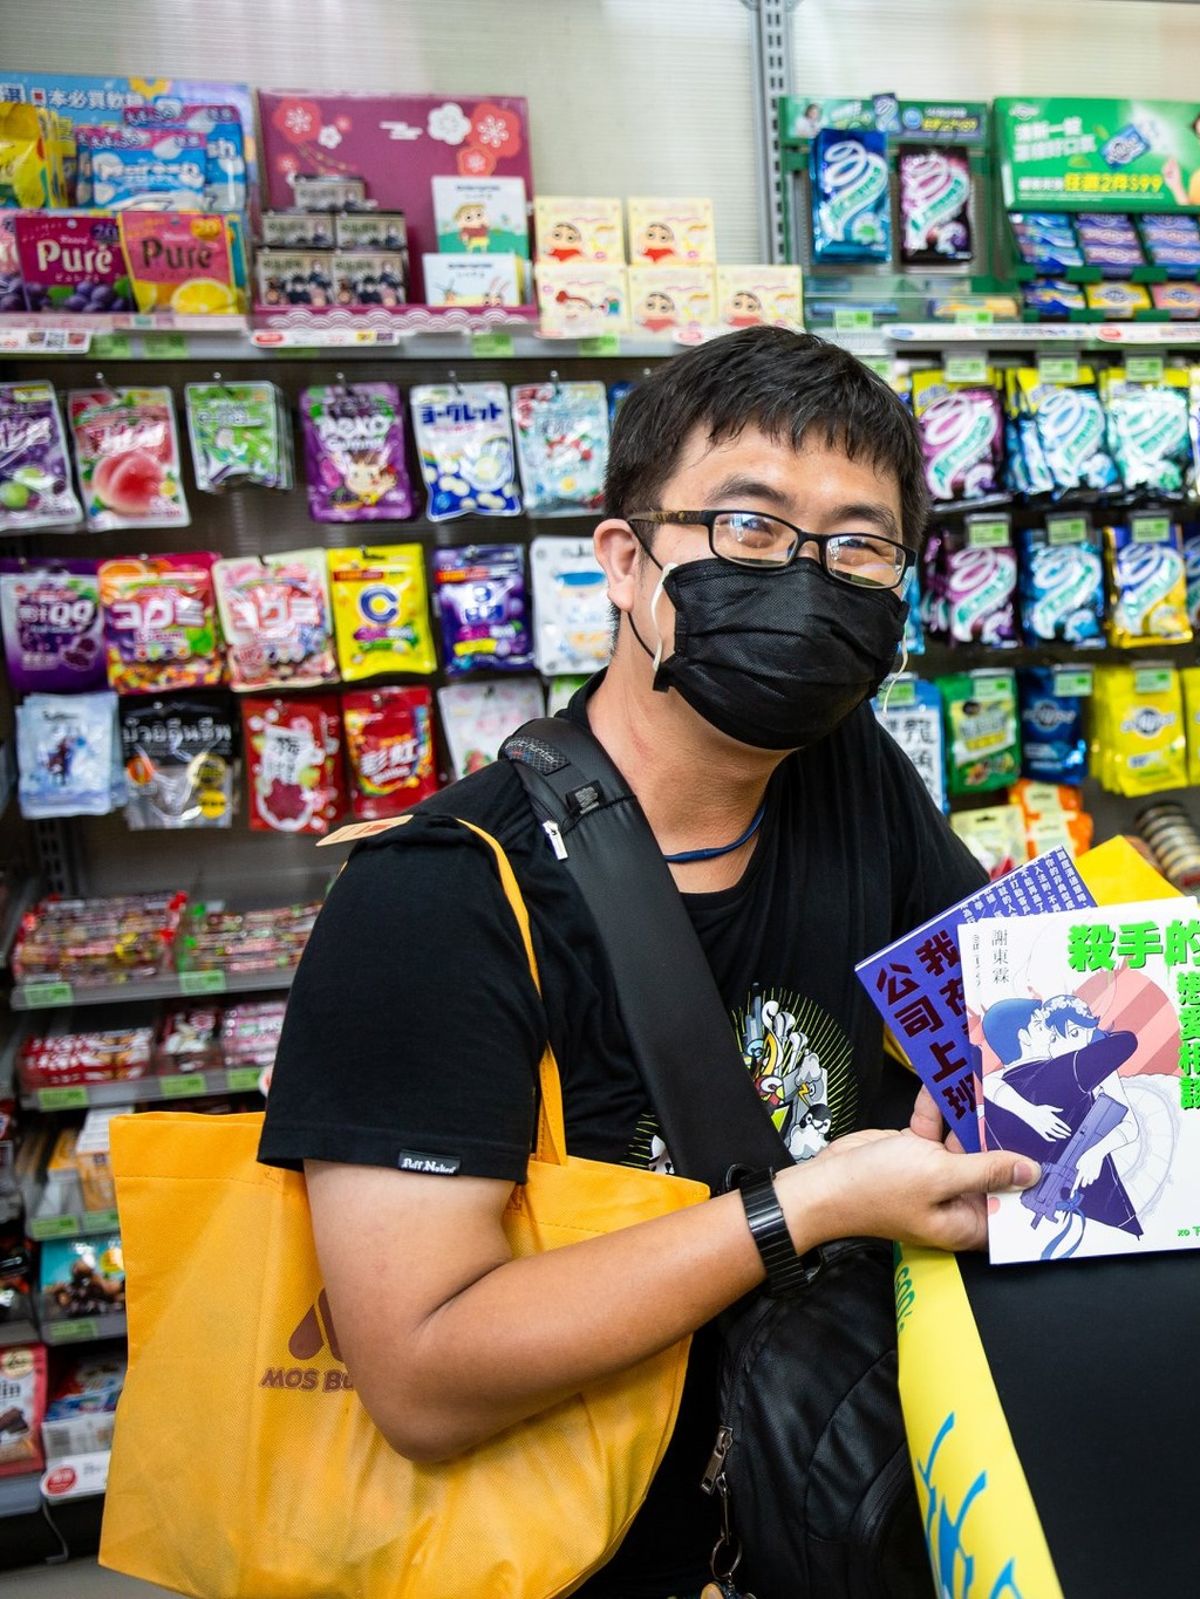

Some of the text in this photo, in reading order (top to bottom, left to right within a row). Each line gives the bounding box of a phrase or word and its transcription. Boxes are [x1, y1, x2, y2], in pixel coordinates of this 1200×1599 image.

[420, 403, 503, 425] ヨーグレット
[876, 963, 978, 1121] 公司上班
[258, 1367, 354, 1393] MOS BU
